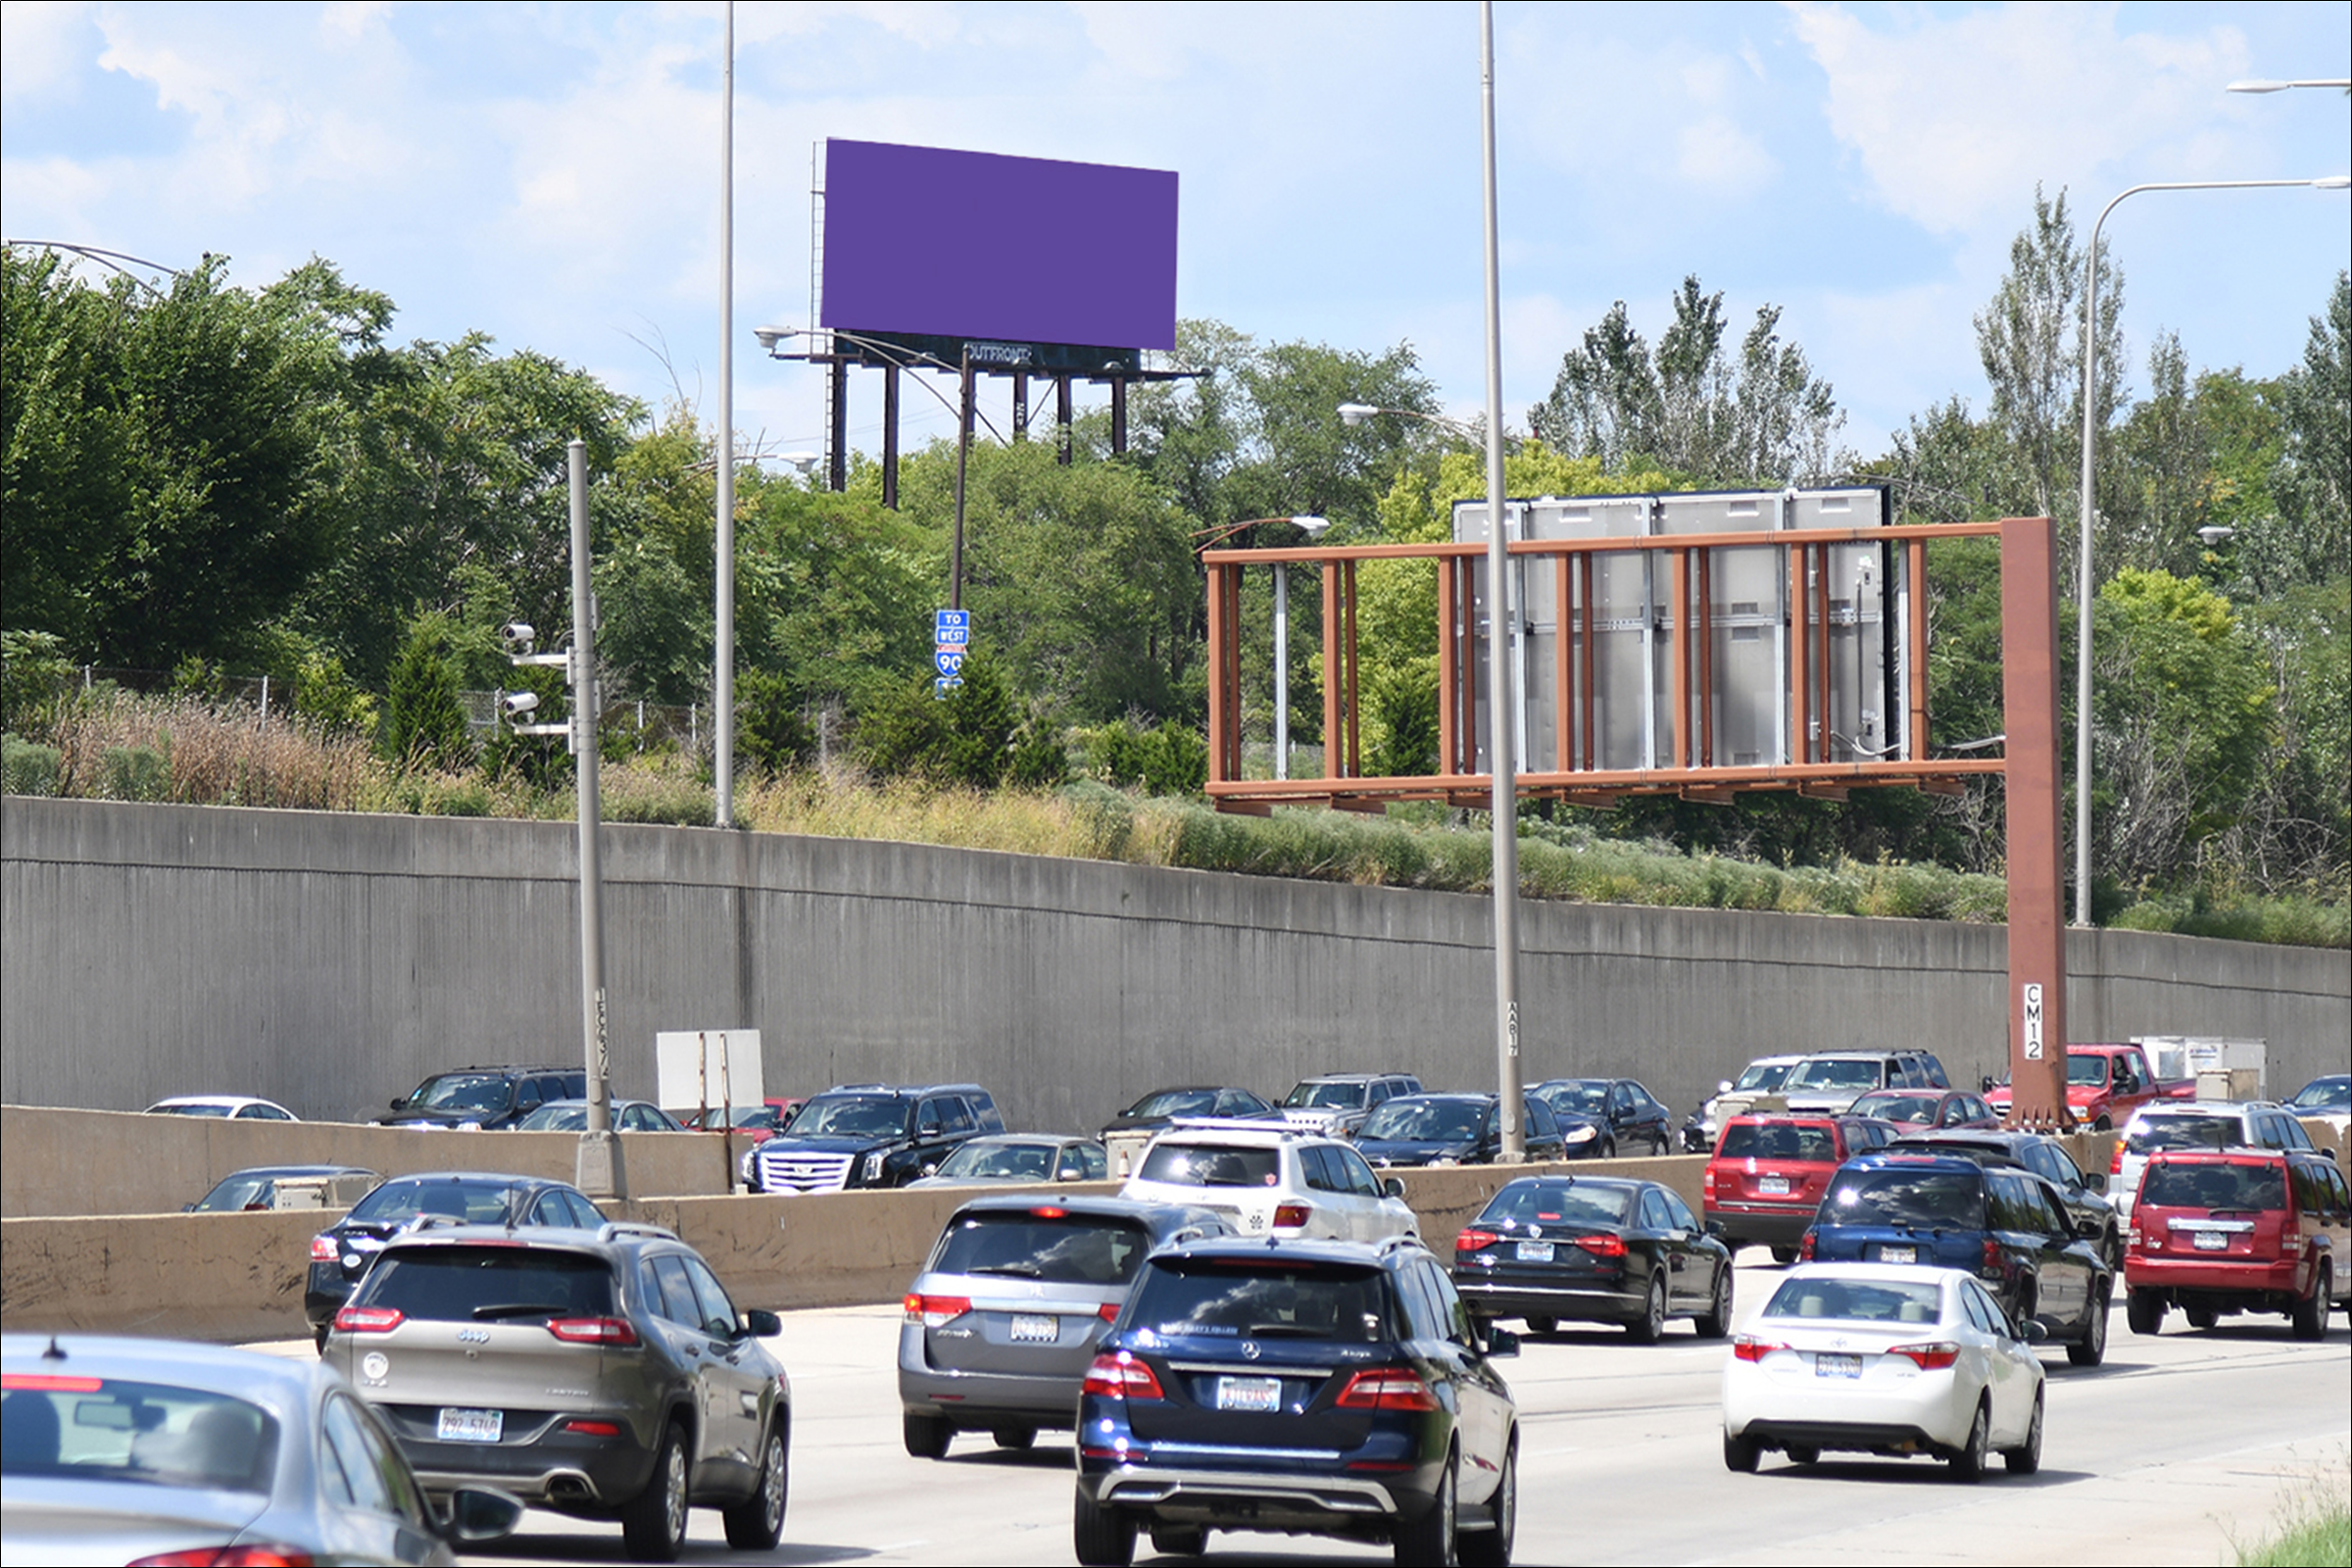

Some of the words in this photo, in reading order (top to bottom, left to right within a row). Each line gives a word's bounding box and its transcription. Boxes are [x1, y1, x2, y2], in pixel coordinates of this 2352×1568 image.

[946, 613, 961, 624] TO
[941, 630, 964, 641] WEST
[940, 654, 962, 671] 90
